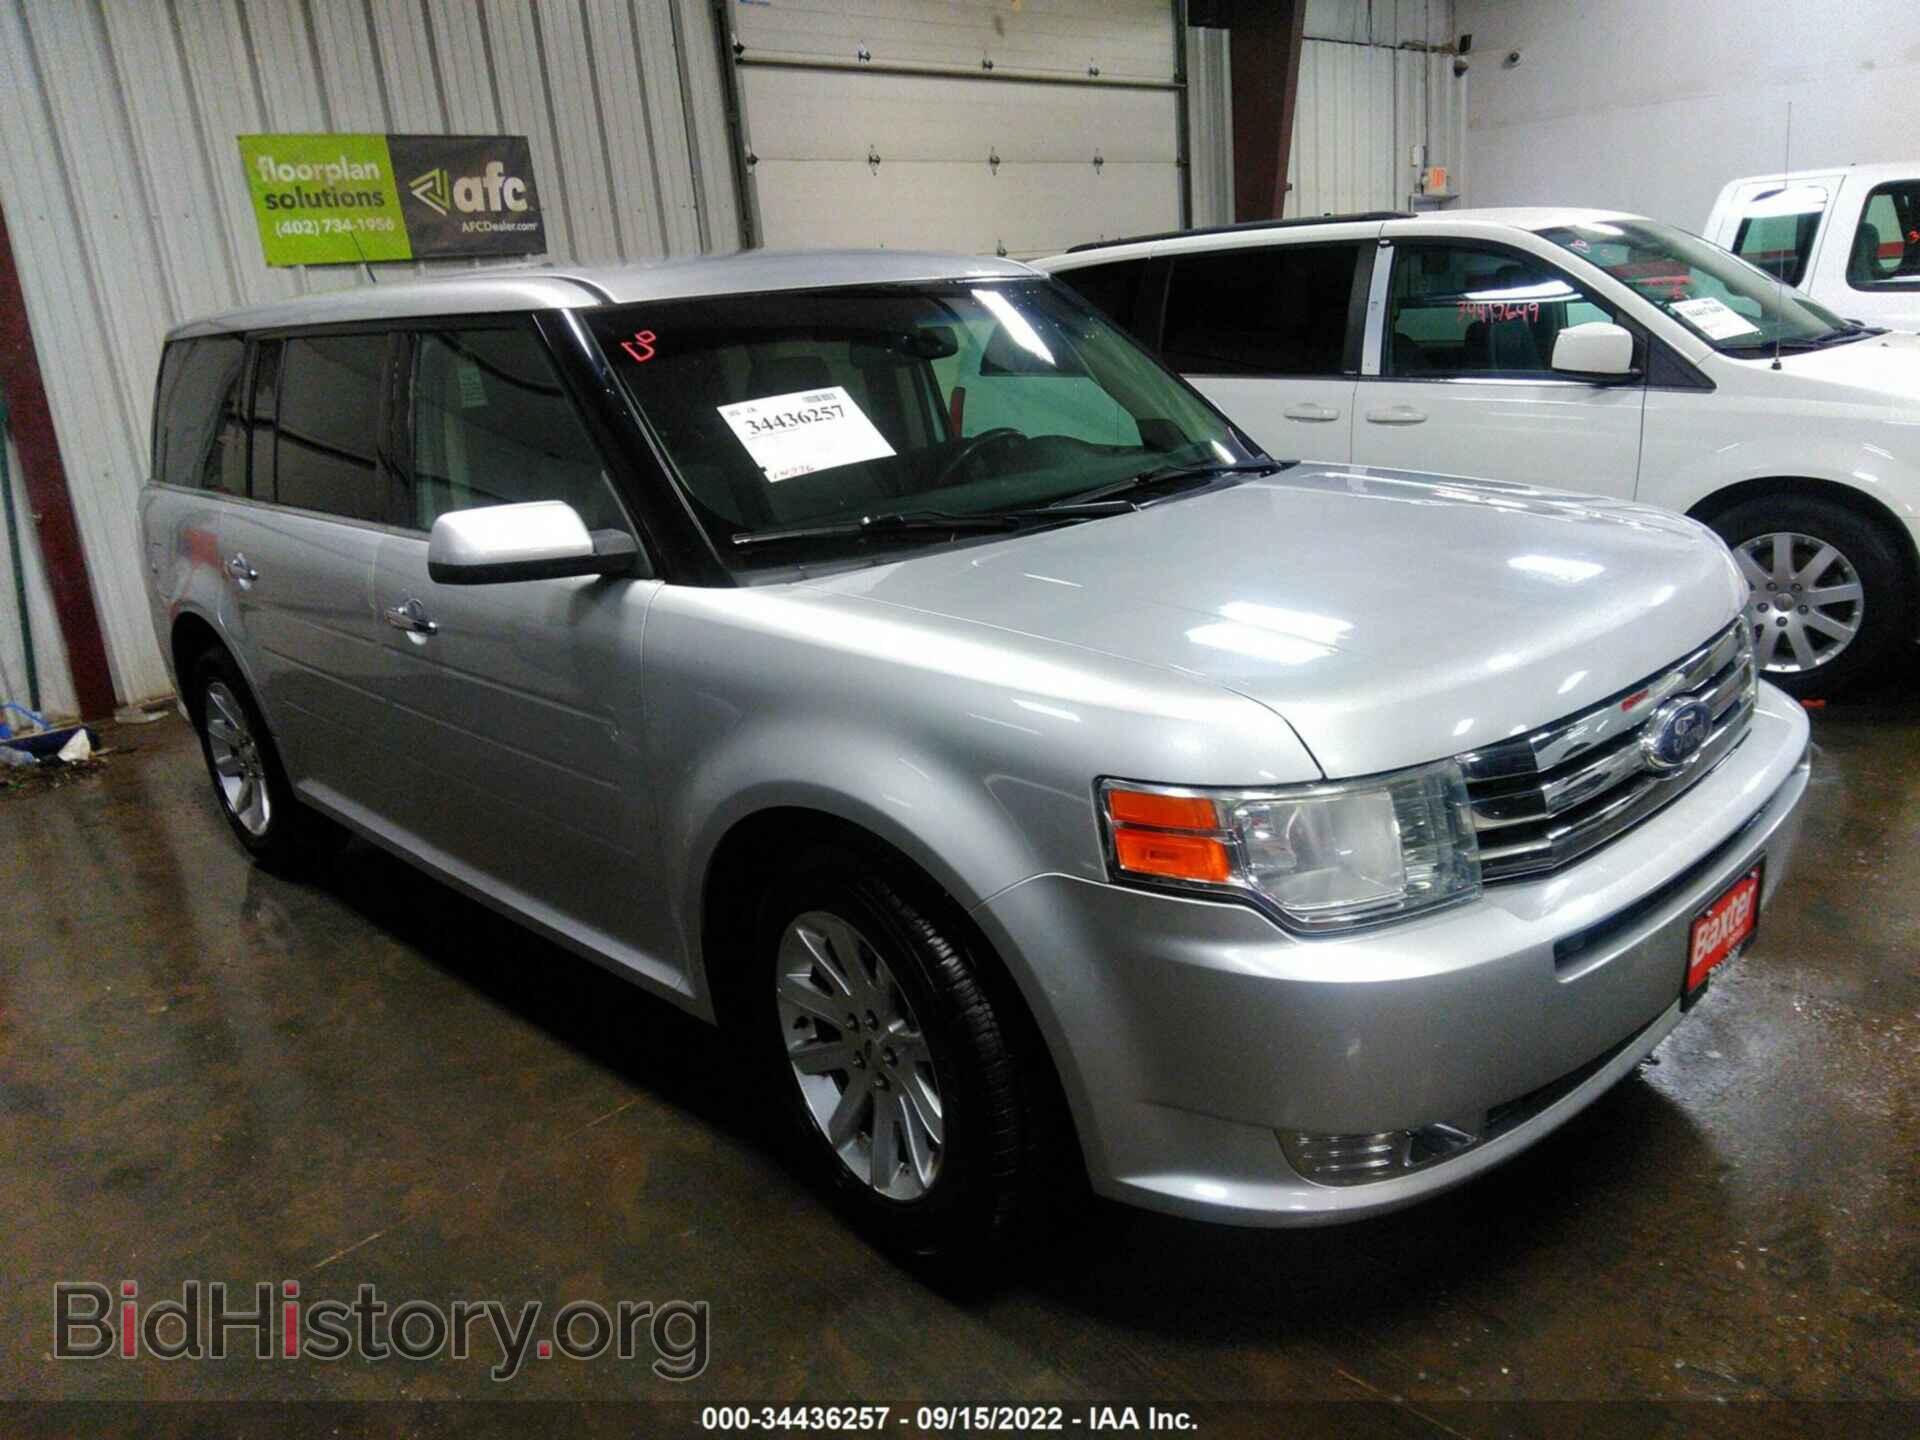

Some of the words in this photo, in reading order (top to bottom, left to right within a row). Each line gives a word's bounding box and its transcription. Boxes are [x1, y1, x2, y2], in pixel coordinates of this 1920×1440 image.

[256, 156, 380, 186] floorplan
[265, 186, 385, 209] solutions
[453, 161, 528, 212] afc
[276, 218, 320, 238] (402)
[462, 221, 537, 232] AFCDealer.com
[745, 404, 845, 435] 34436257
[1691, 882, 1755, 968] Baxter
